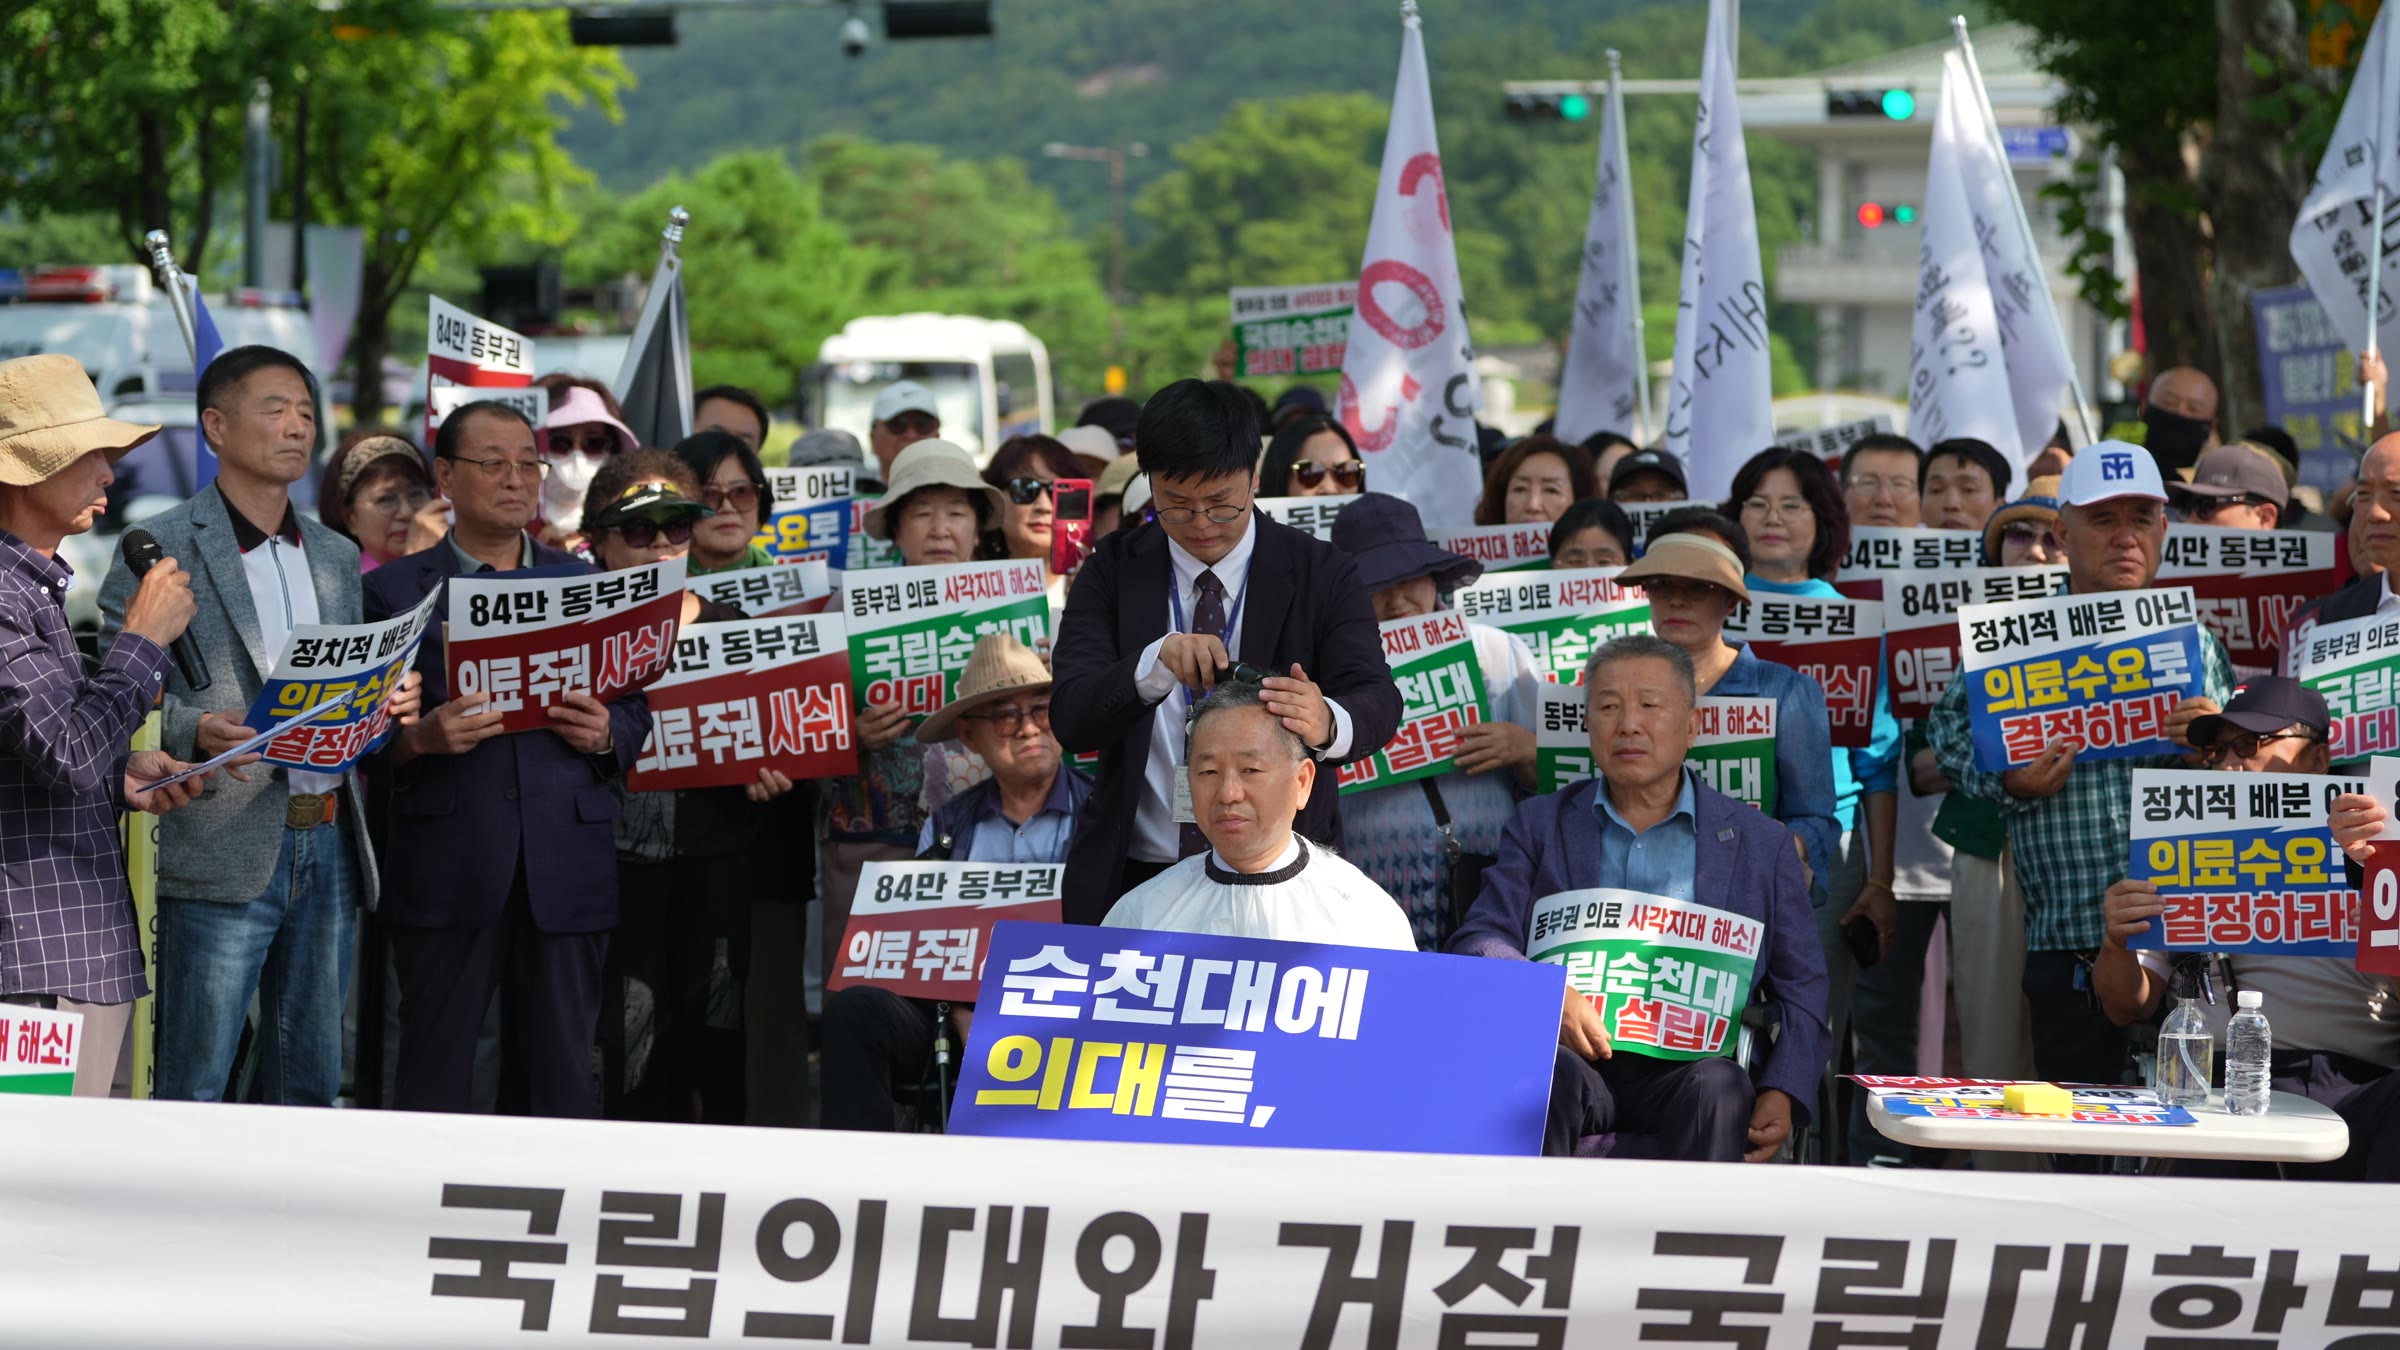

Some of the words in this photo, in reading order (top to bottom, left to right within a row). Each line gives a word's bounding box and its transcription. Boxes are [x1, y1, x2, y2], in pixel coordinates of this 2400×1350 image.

[437, 314, 466, 352] 84만
[471, 326, 521, 368] 동부권
[765, 475, 797, 502] 분
[807, 470, 851, 499] 아닌
[2220, 536, 2309, 568] 동부권
[469, 590, 548, 627] 84만
[561, 567, 659, 618] 동부권
[710, 568, 805, 609] 동부권
[851, 583, 902, 618] 동부권
[906, 579, 939, 609] 의료
[944, 570, 1007, 603] 사각지대
[1008, 565, 1044, 595] 해소!
[1463, 587, 1513, 617] 동부권
[1518, 584, 1552, 611] 의료
[1558, 577, 1626, 607] 사각지대
[1902, 581, 1972, 616] 84만
[290, 633, 374, 668] 정치적
[376, 616, 415, 659] 배분
[721, 620, 820, 666] 동부권
[1422, 614, 1467, 646] 해소!
[1761, 602, 1856, 635] 동부권
[1970, 609, 2060, 653] 정치적
[2067, 600, 2126, 637] 배분
[2135, 591, 2194, 627] 아닌
[2312, 631, 2362, 665] 동부권
[2366, 623, 2400, 651] 의료
[457, 656, 524, 718] 의료
[528, 643, 591, 708] 주권
[597, 618, 674, 694] 사수!
[1984, 641, 2192, 714] 의료수요로
[697, 696, 765, 765] 주권
[769, 682, 850, 757] 사수!
[1544, 701, 1590, 732] 동부
[1727, 705, 1771, 736] 해소!
[2329, 705, 2399, 760] 의대
[2142, 784, 2236, 822] 정치적
[2249, 783, 2311, 819] 배분
[874, 872, 948, 904] 84만
[958, 868, 1057, 900] 동부권
[841, 930, 912, 980] 의료
[912, 928, 979, 981] 주권
[1534, 904, 1581, 941] 동부권
[1584, 902, 1622, 929] 의료
[1627, 904, 1707, 942] 사각지대
[1711, 917, 1757, 955] 해소!
[998, 943, 1369, 1041] 순천대에
[17, 1020, 74, 1067] 해소!
[1615, 996, 1730, 1053] 설립!
[974, 1034, 1277, 1128] 의대를,
[427, 1181, 1216, 1350] 국립의대와
[1276, 1218, 1583, 1350] 거점
[1634, 1230, 2400, 1350] 국립대학
